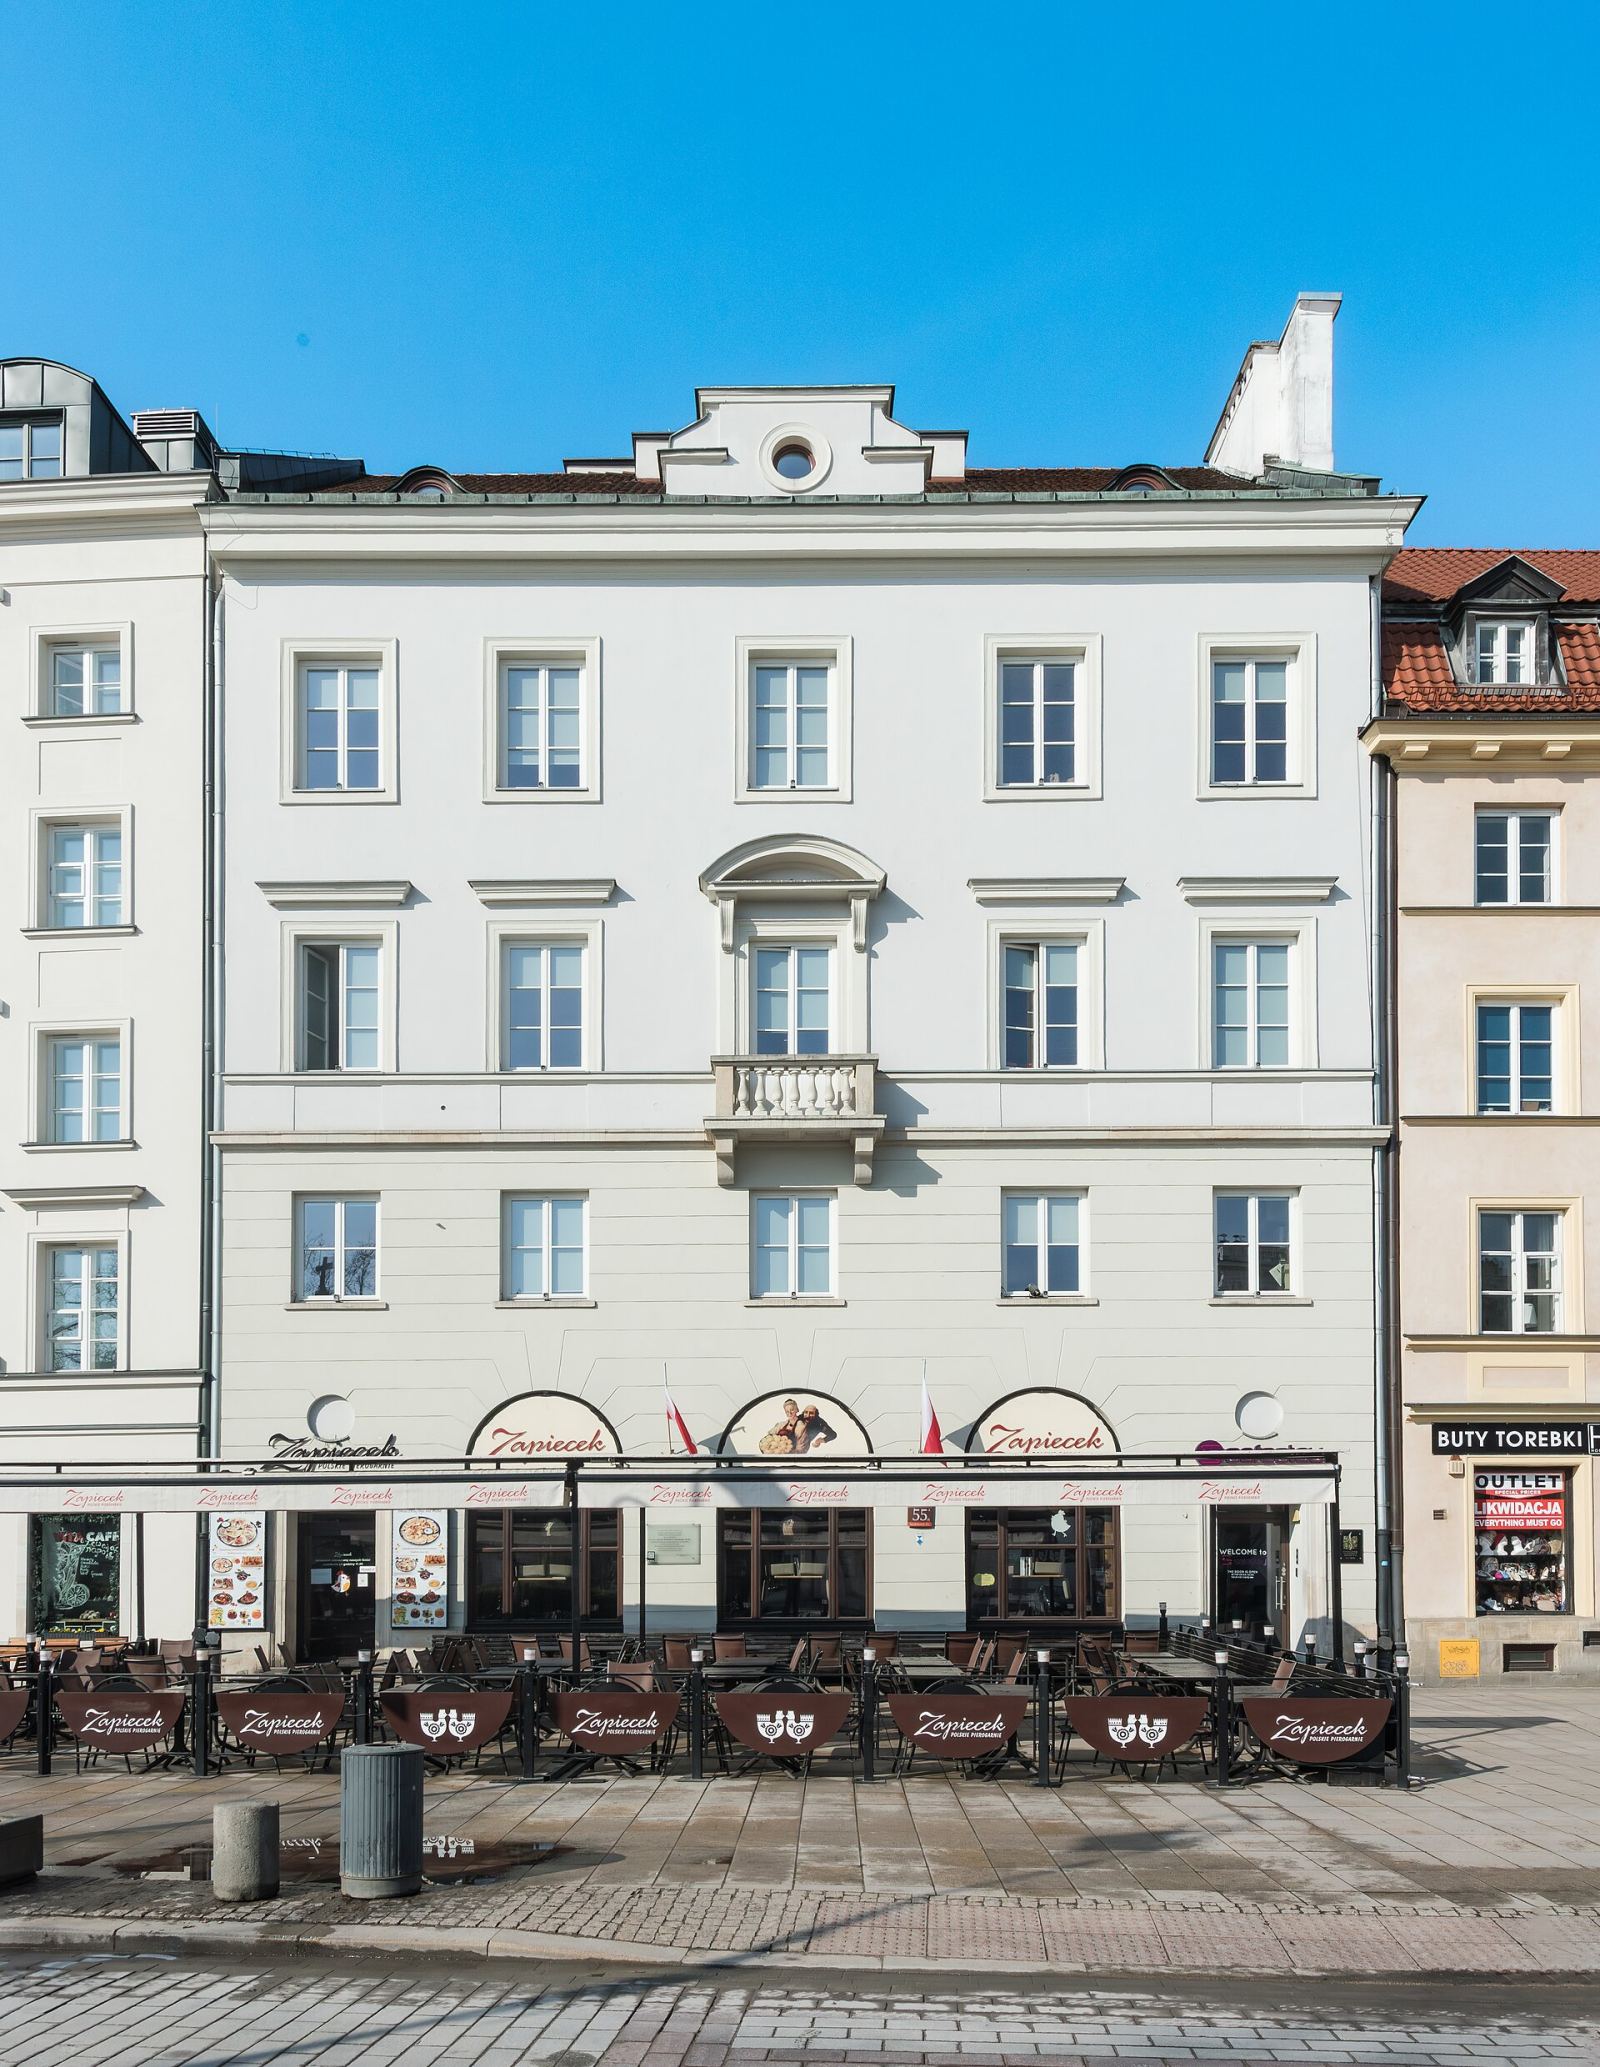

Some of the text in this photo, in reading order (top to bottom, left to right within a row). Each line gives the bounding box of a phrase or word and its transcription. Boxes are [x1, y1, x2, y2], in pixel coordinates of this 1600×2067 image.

[489, 1428, 606, 1456] Zapiecek
[985, 1424, 1104, 1453] Zapiecek
[1438, 1431, 1582, 1447] BUTY TOREBKI
[1475, 1475, 1560, 1488] OUTLET
[63, 1489, 125, 1508] Zapiecek
[197, 1488, 258, 1507] Zapiecek
[331, 1487, 393, 1506] Zapiecek
[466, 1484, 528, 1504] Zapiecek
[650, 1485, 712, 1504] Zapiecek
[786, 1484, 849, 1504] Zapiecek
[922, 1484, 985, 1503] Zapiecek
[1060, 1483, 1124, 1502] Zapiecek
[1198, 1482, 1262, 1502] Zapiecek
[912, 1508, 928, 1521] 55
[1474, 1502, 1562, 1515] LIKWIDACJA
[1474, 1519, 1562, 1527] EVERYTHING MUST GO
[1219, 1548, 1258, 1556] WELCOME
[81, 1708, 164, 1735] Zapiecek
[240, 1709, 324, 1737] Zapiecek
[571, 1709, 659, 1737] Zapiecek
[914, 1711, 1006, 1740] Zapiecek
[1270, 1715, 1367, 1744] Zapiecek
